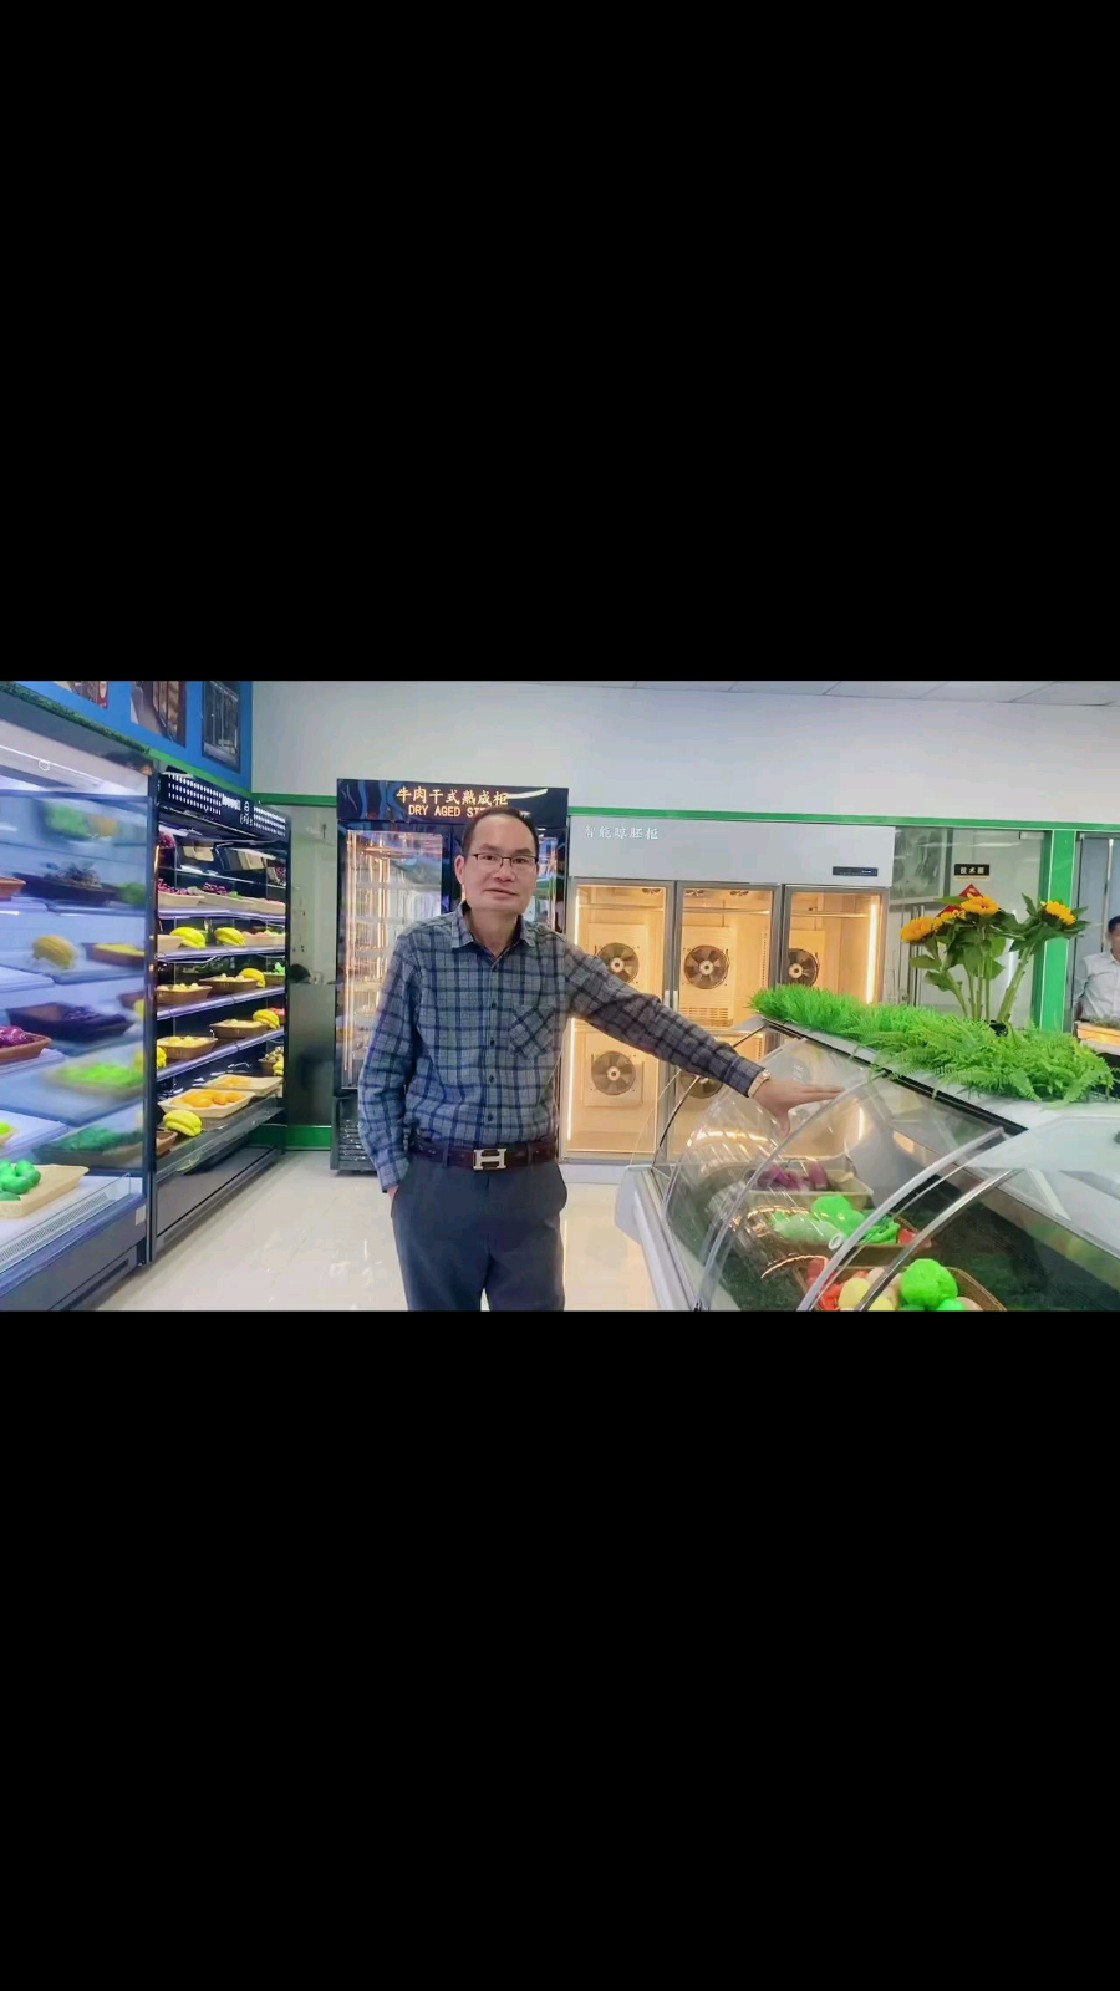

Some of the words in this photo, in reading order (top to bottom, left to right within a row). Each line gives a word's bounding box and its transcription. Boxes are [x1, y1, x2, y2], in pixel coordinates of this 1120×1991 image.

[396, 785, 509, 806] 牛肉干式熟成柜
[408, 804, 428, 816] DRY
[434, 805, 461, 817] AGED
[473, 1148, 507, 1170] H
